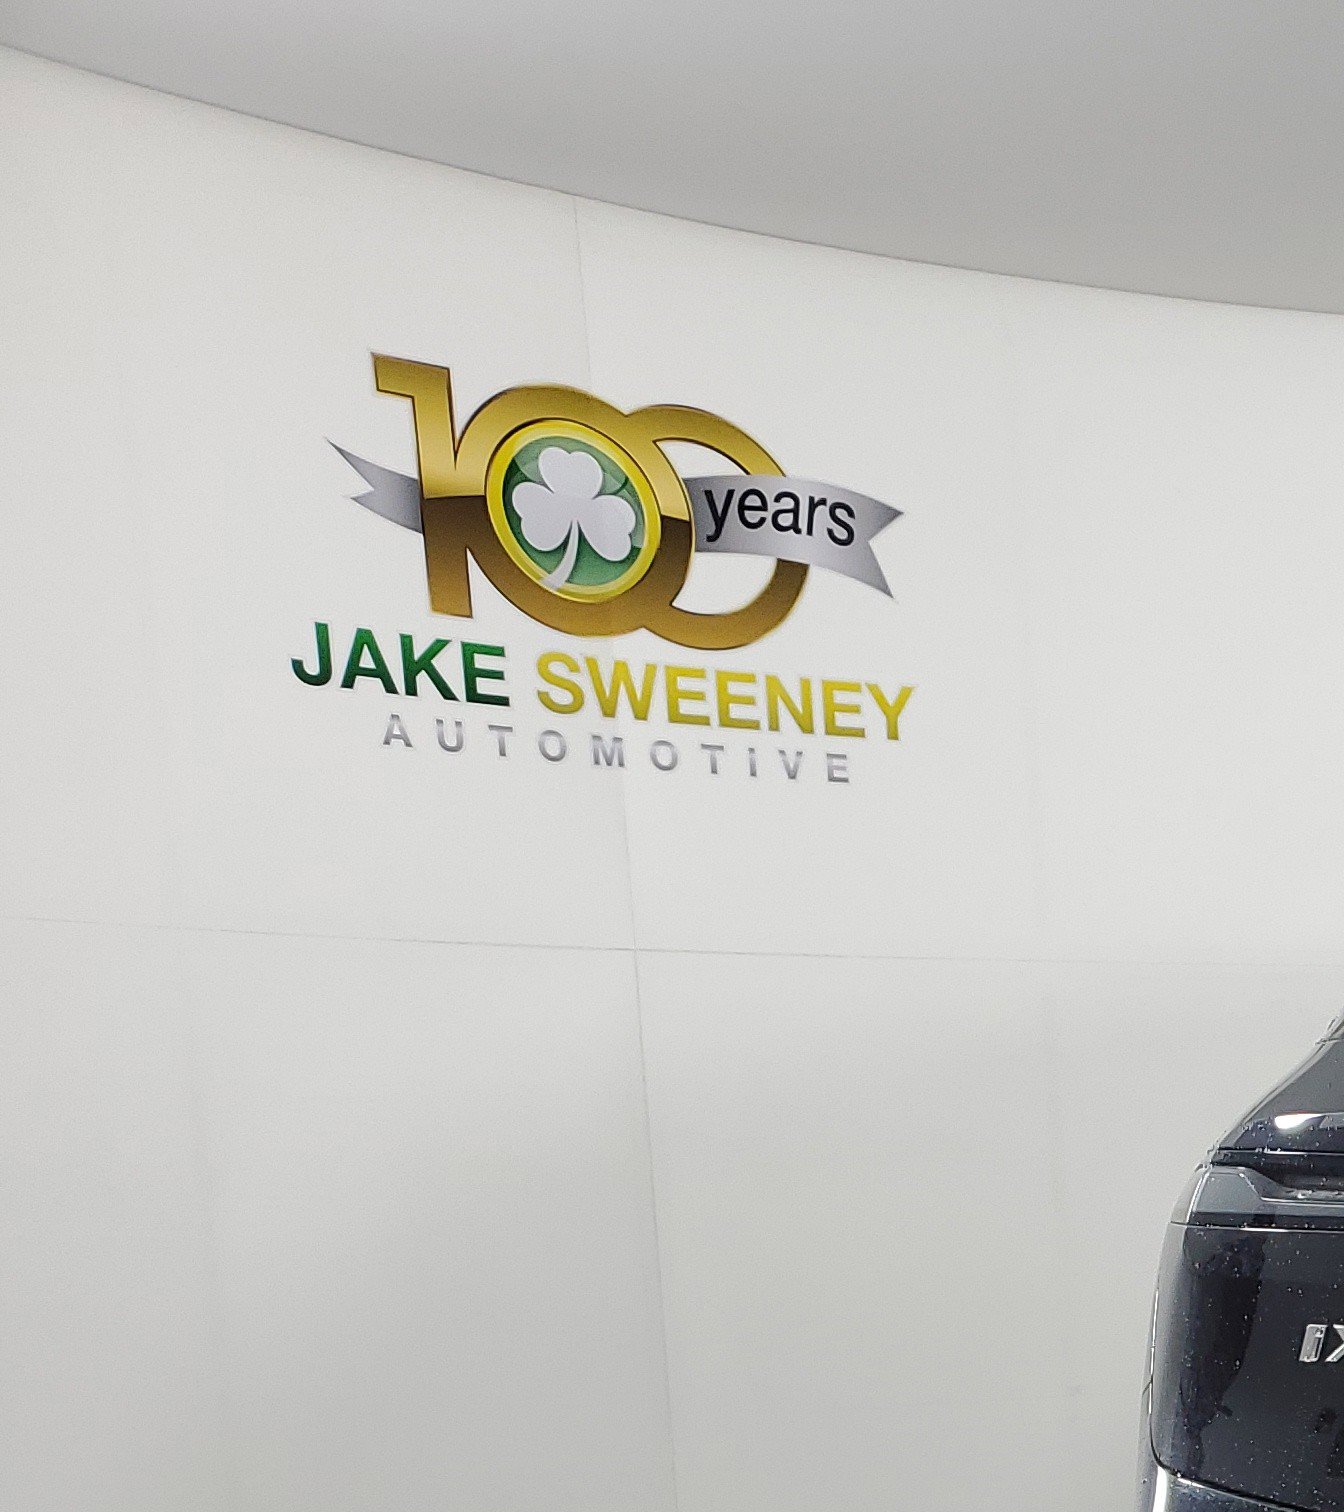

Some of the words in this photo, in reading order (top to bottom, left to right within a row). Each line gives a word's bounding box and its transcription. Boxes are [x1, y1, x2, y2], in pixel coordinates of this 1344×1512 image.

[371, 352, 811, 651] 100
[704, 482, 856, 547] years
[291, 621, 511, 707] JAKE
[535, 652, 915, 741] SWEENEY
[382, 714, 850, 784] AUTOMOTIVE
